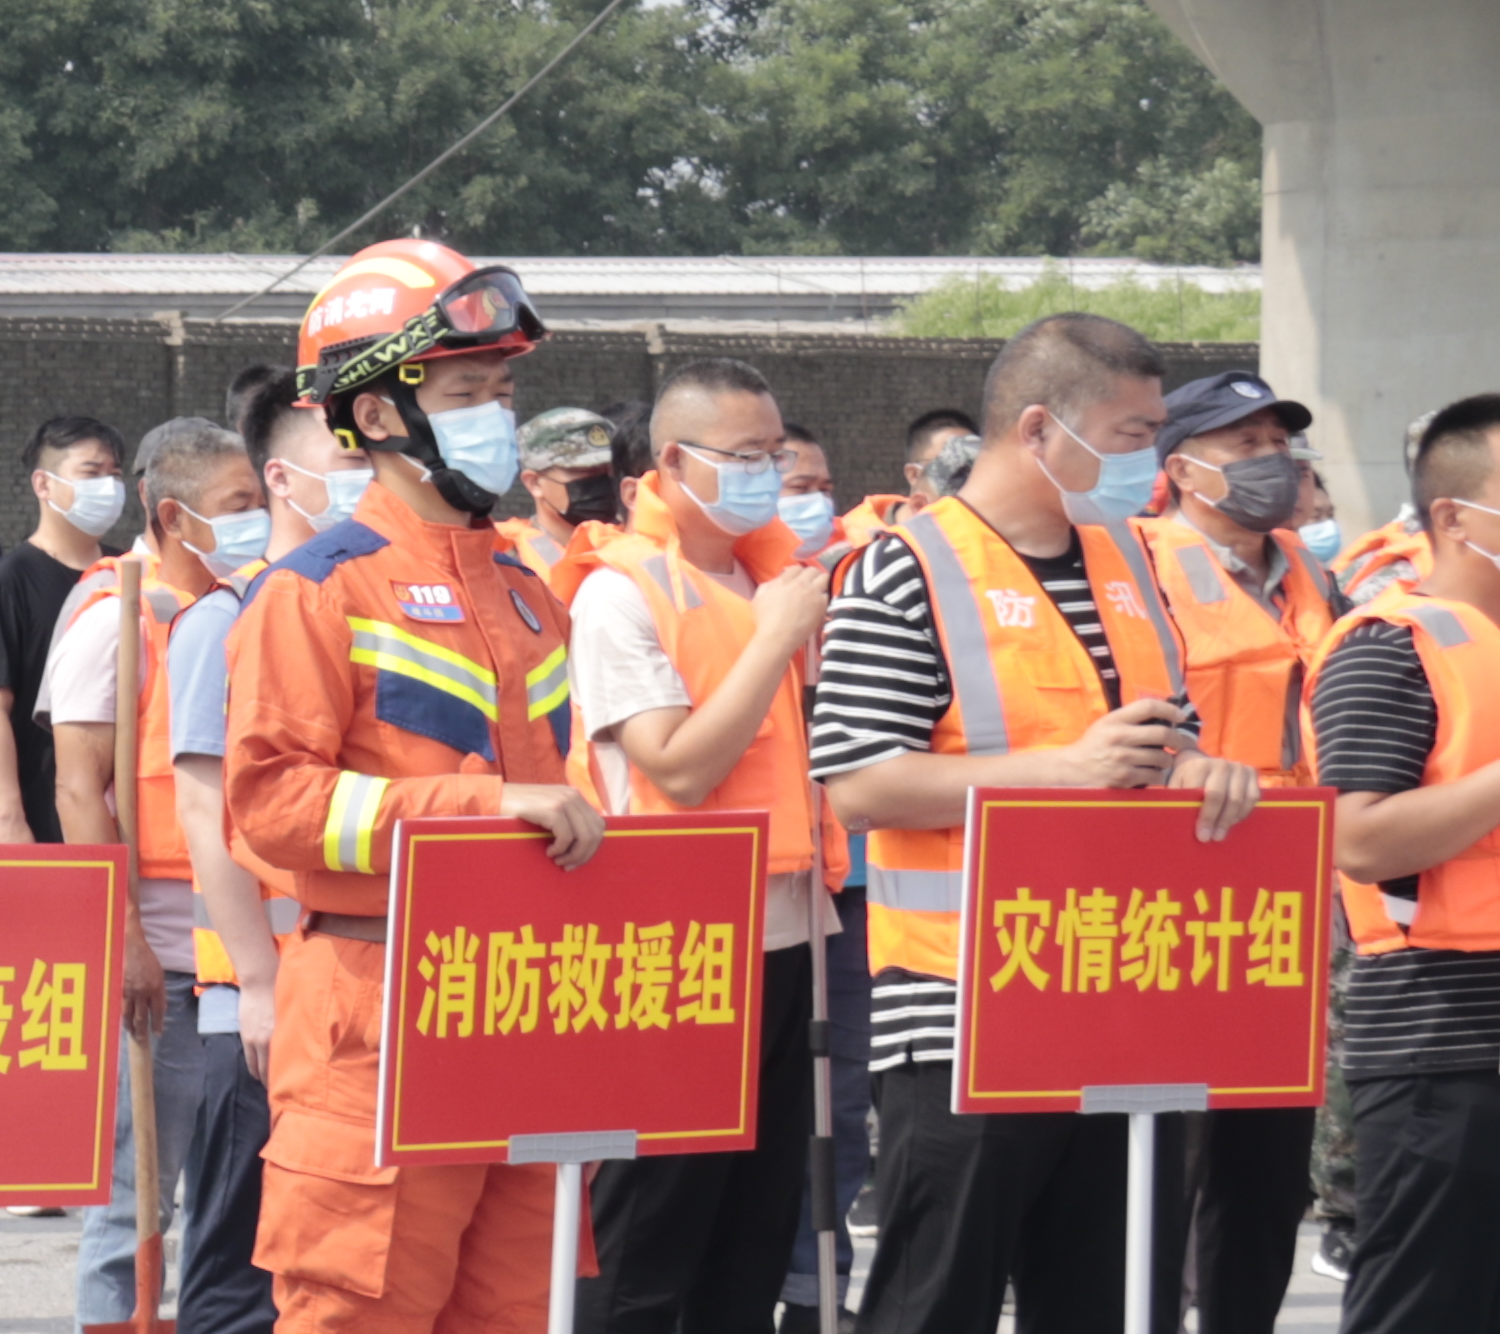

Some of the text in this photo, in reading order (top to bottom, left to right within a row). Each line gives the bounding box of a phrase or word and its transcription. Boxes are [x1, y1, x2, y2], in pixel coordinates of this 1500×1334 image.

[408, 584, 452, 605] 119
[986, 589, 1036, 628] 防
[989, 886, 1305, 993] 灾情统计组
[415, 920, 736, 1039] 消防救援组
